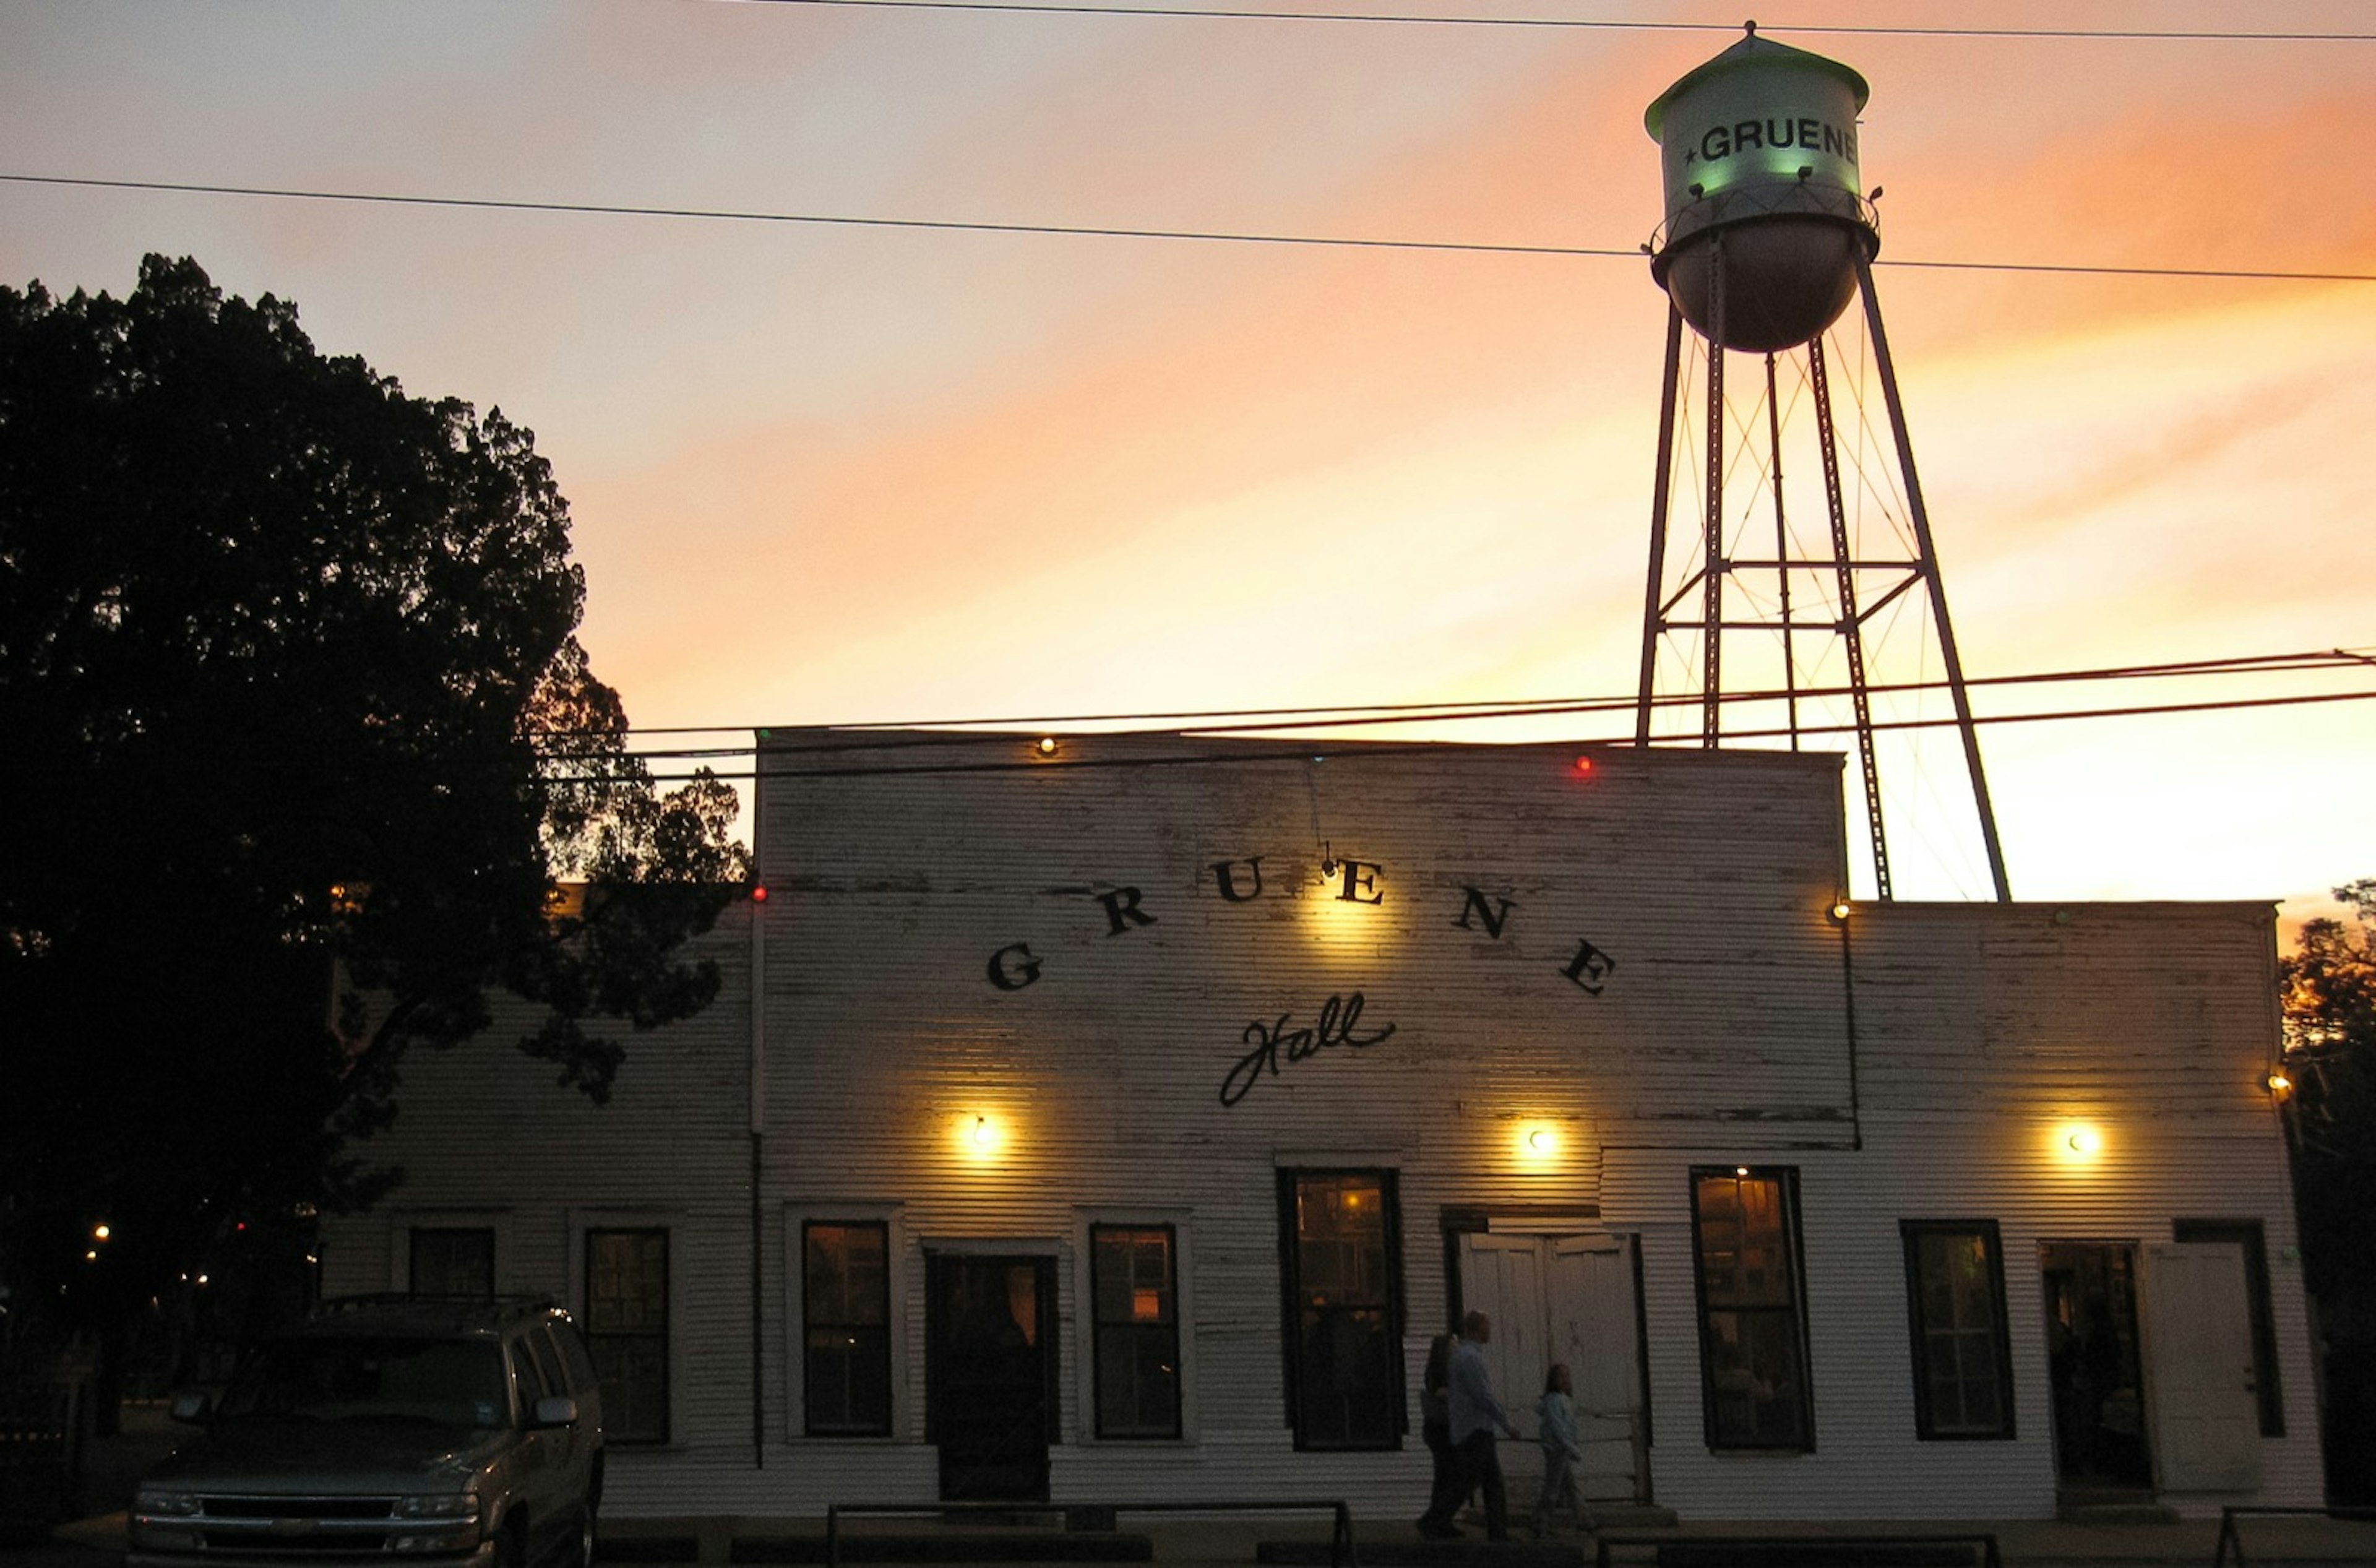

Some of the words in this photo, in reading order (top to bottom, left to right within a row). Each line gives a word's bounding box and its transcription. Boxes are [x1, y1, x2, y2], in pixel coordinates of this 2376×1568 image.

[1702, 118, 1856, 165] GRUENE
[988, 856, 1616, 995] GRUENE
[1220, 993, 1397, 1107] Hall
